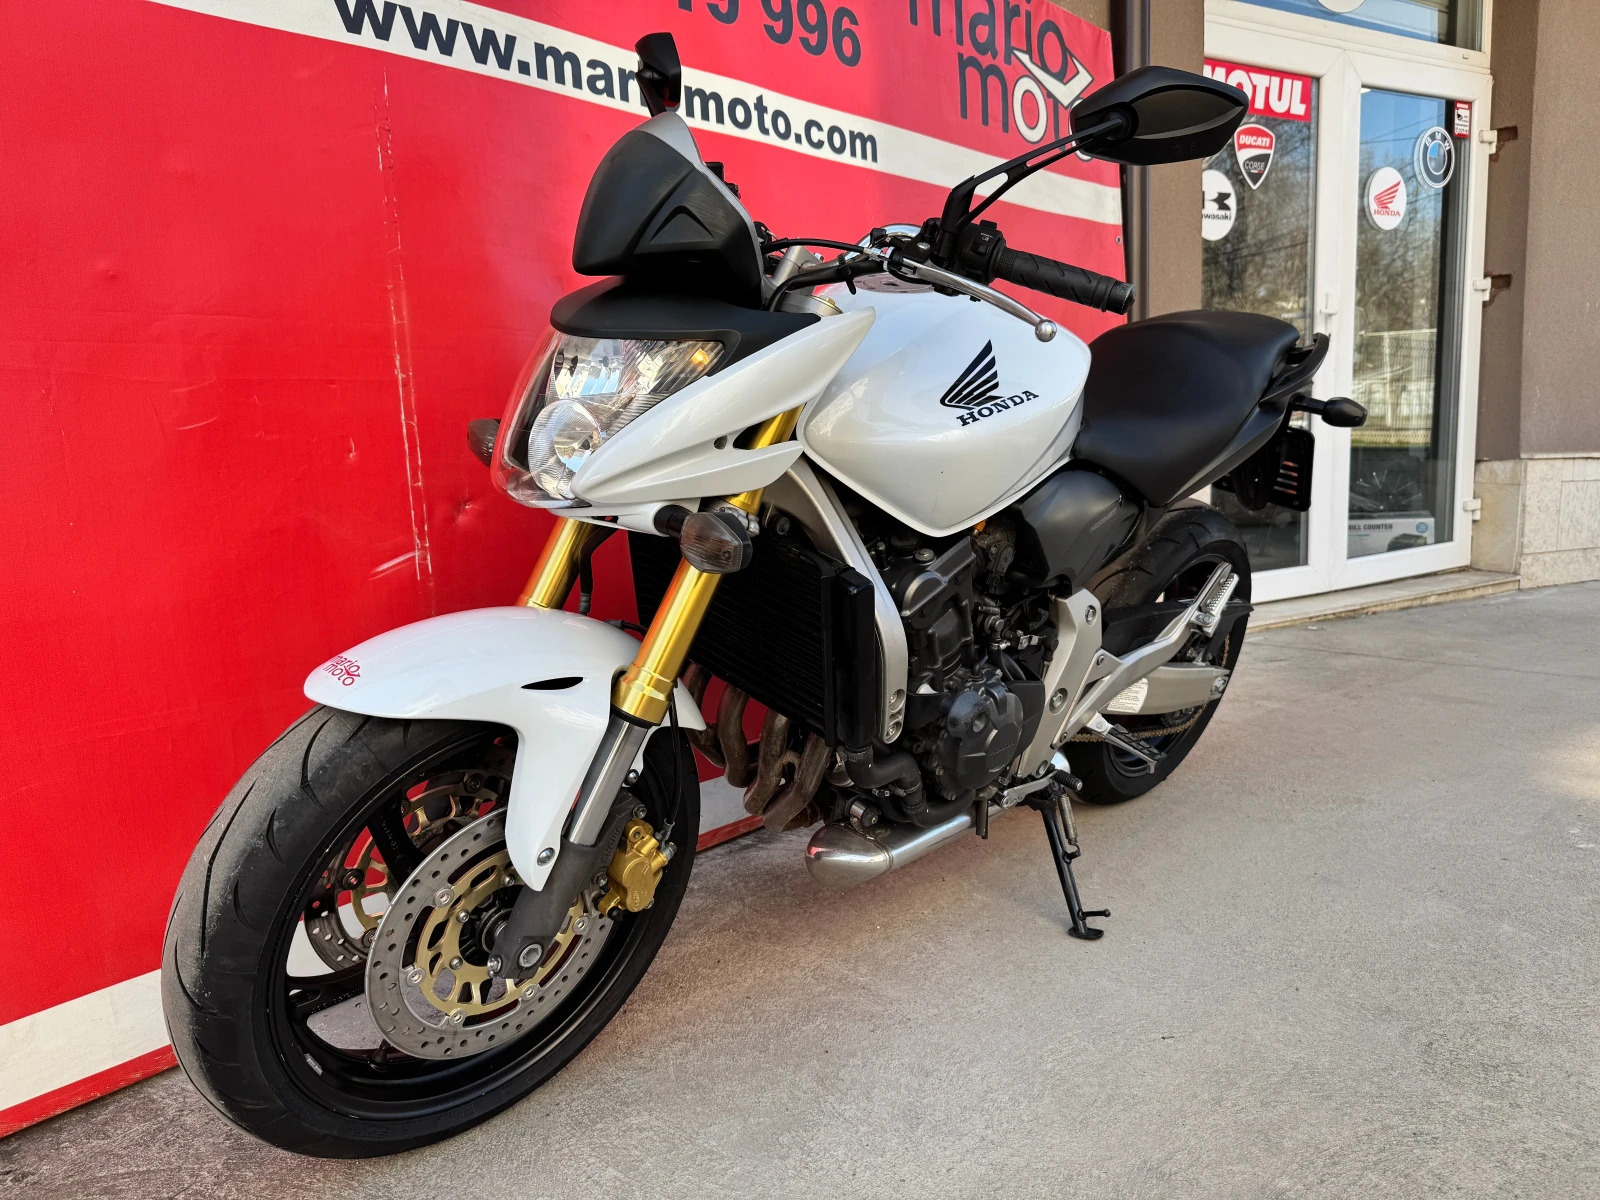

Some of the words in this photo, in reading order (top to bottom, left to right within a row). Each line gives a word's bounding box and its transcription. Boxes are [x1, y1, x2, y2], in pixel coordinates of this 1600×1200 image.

[760, 0, 862, 67] 996
[334, 0, 878, 164] www.marmoto.com
[958, 51, 1094, 162] mot
[1239, 134, 1271, 147] DUCATI
[1244, 160, 1265, 170] CORSE
[1202, 212, 1231, 220] wasaki
[1373, 208, 1401, 217] HONDA
[956, 390, 1040, 427] HONDA
[1363, 523, 1393, 531] COUNTER
[328, 655, 361, 674] mario
